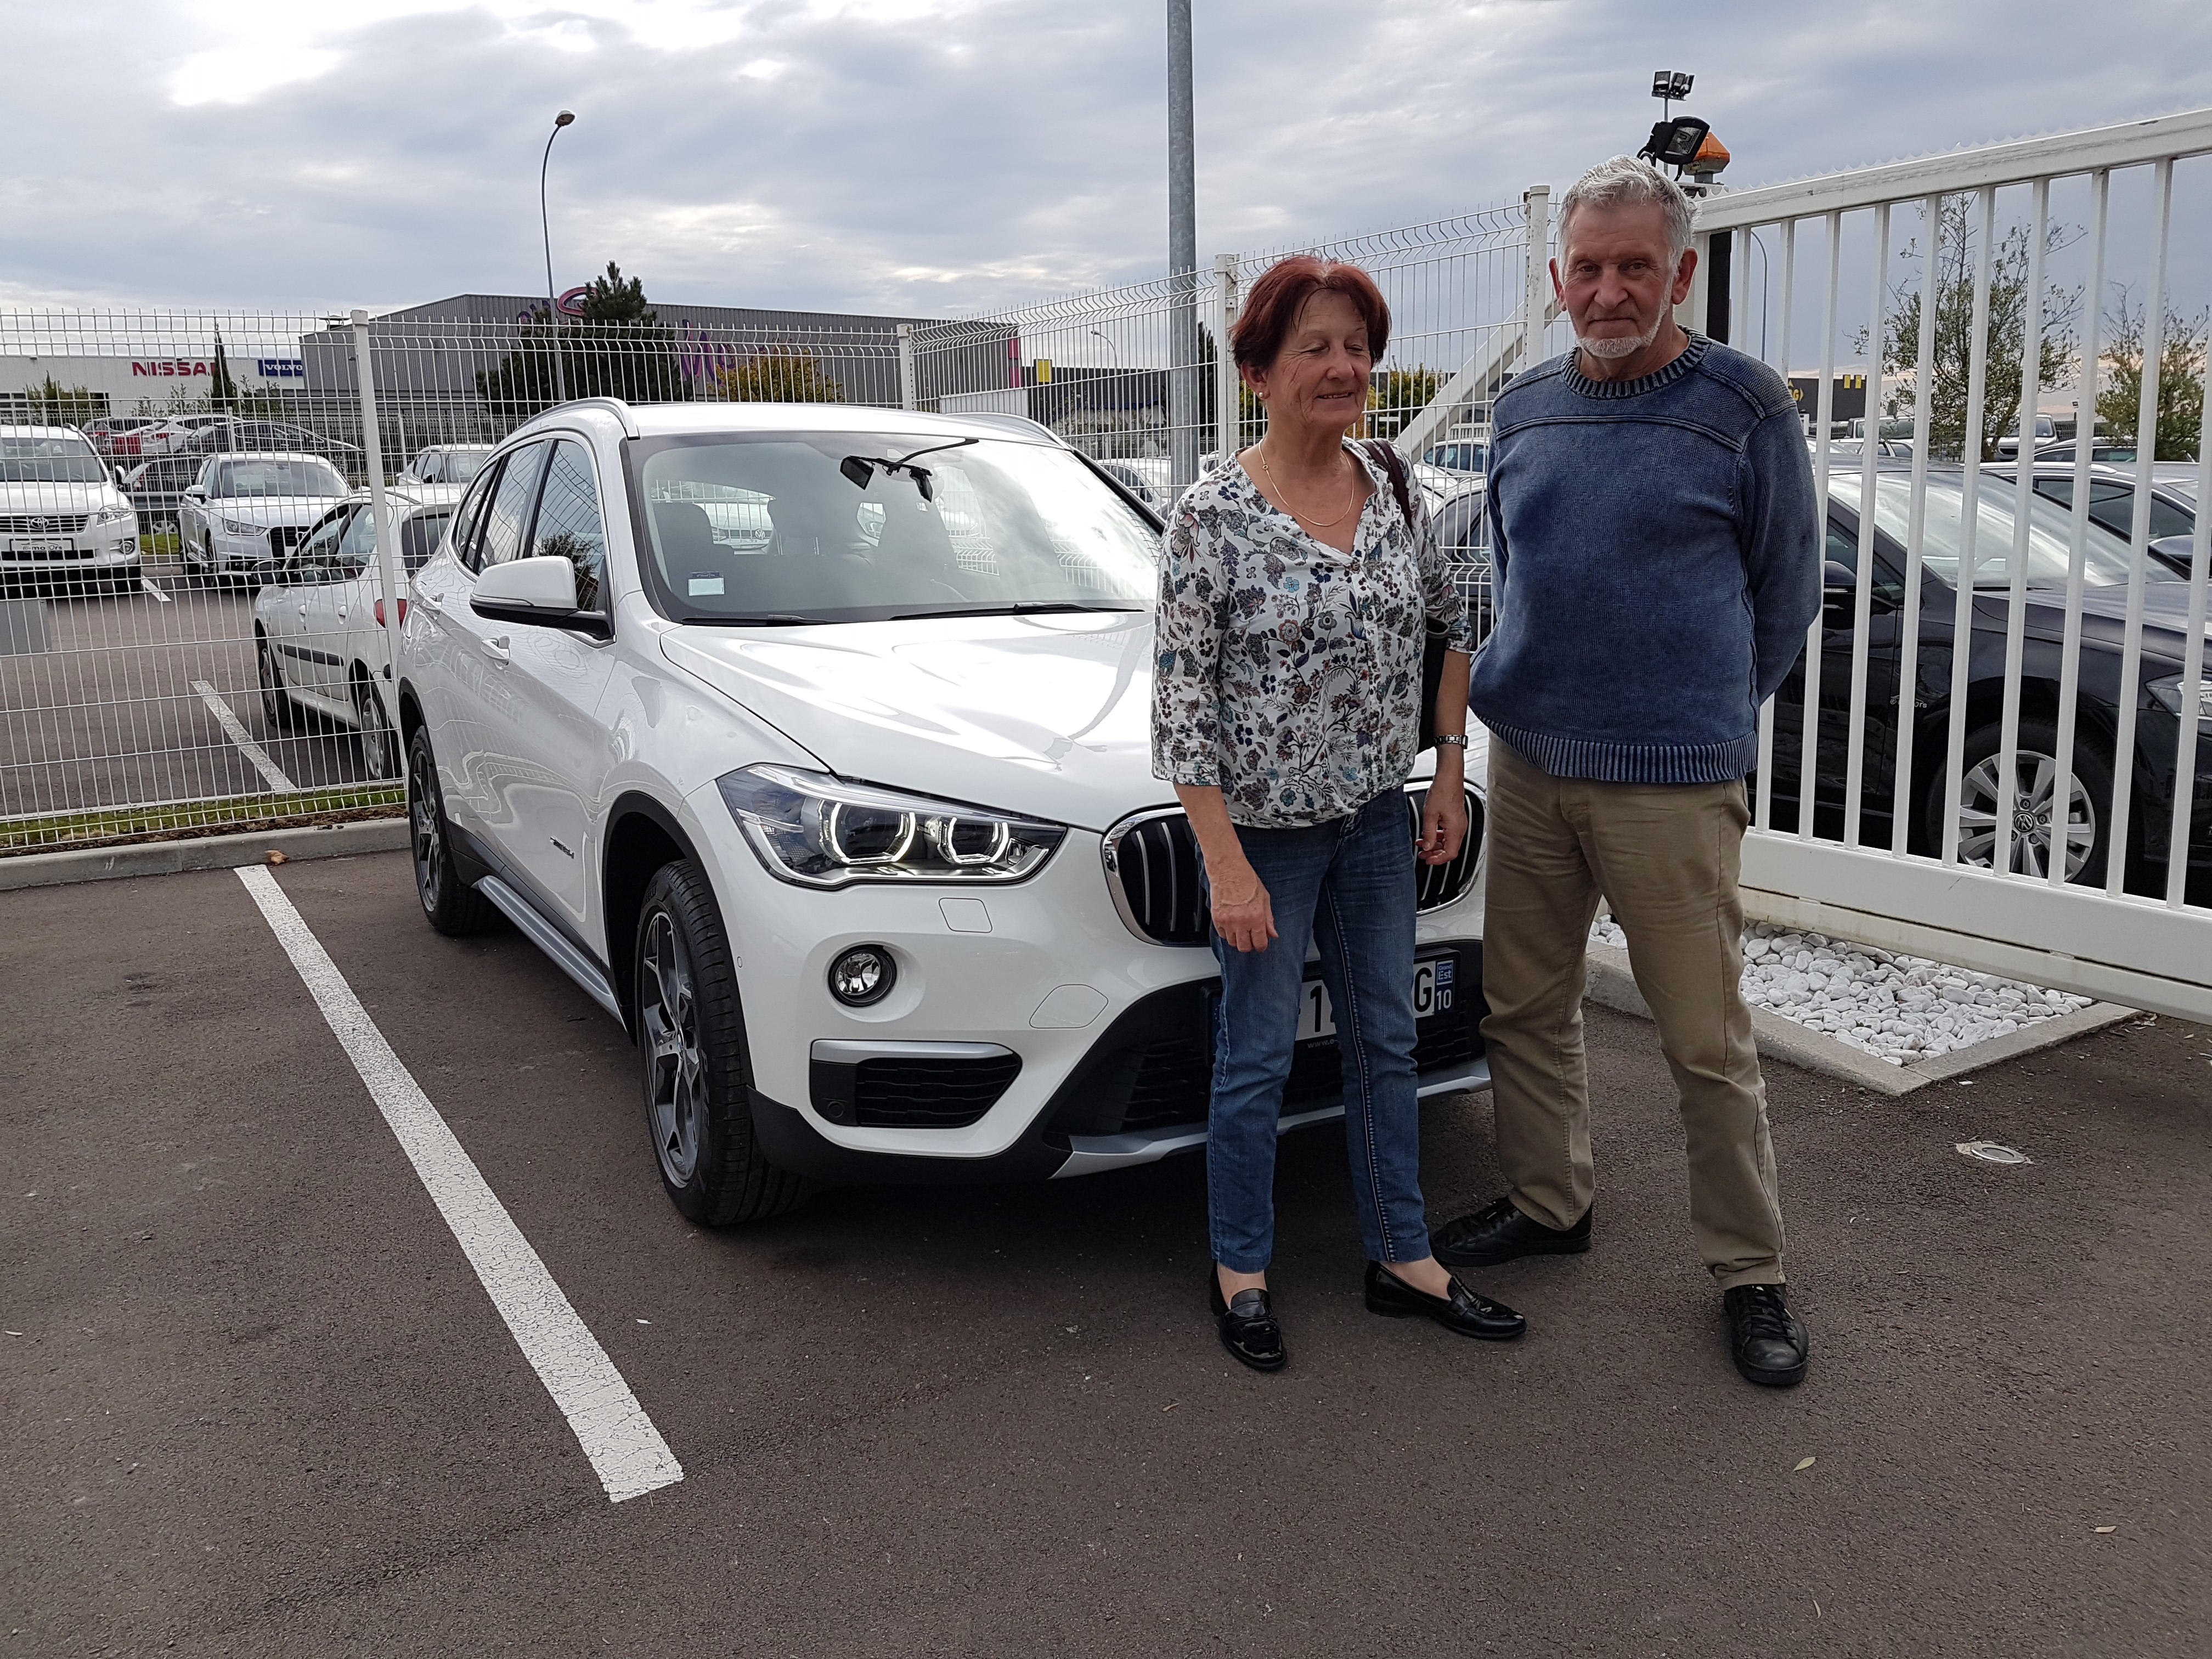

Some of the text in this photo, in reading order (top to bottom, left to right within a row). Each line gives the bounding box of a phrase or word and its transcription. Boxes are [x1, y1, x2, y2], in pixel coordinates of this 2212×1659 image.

[132, 362, 215, 376] NISSA
[1438, 970, 1452, 980] Est
[1436, 989, 1452, 1010] 10
